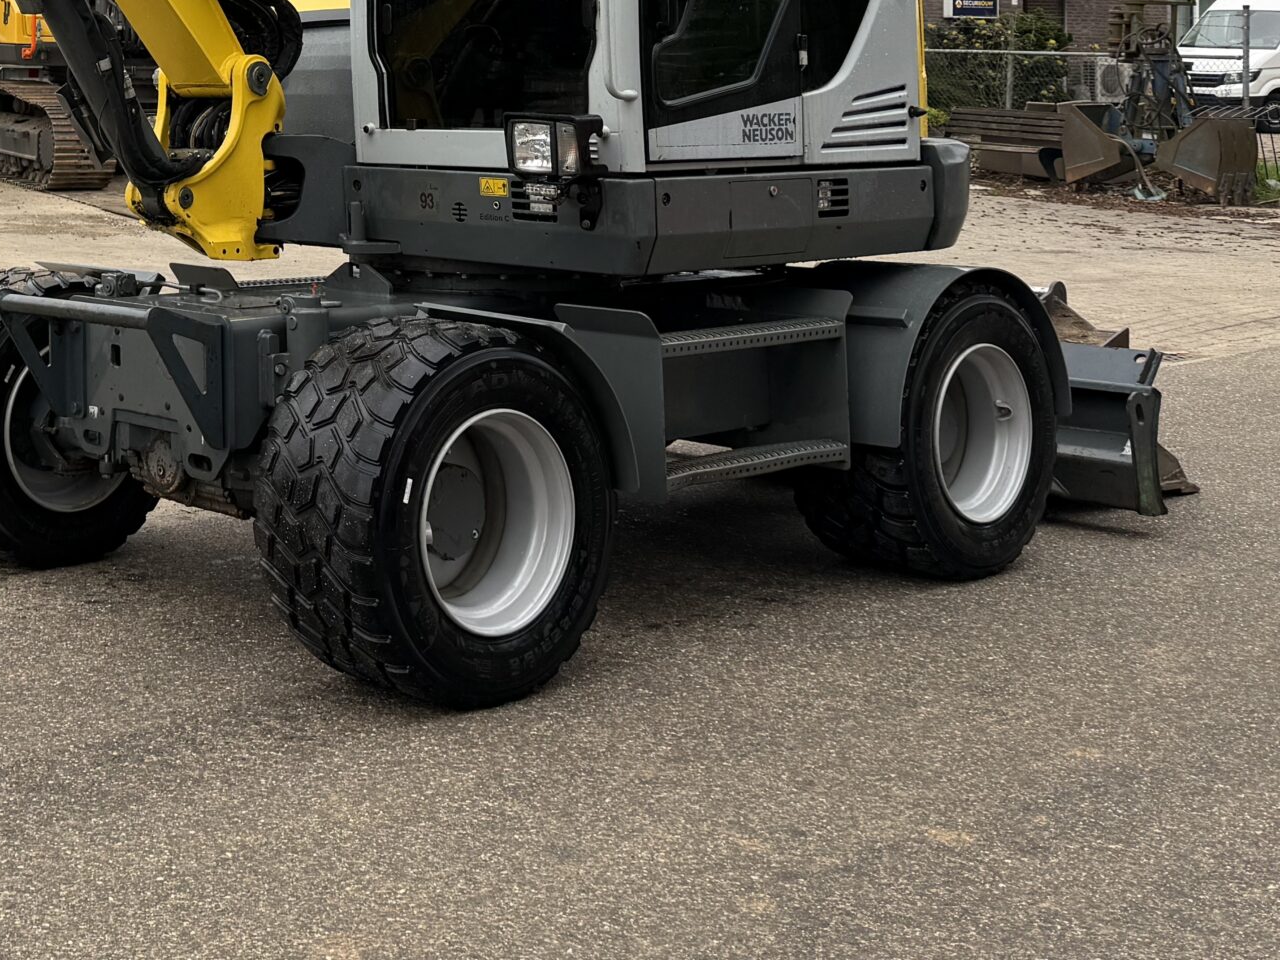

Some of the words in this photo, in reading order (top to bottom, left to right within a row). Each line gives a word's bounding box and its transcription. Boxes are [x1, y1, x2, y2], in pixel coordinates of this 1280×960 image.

[741, 112, 792, 128] WACKER
[742, 127, 794, 143] NEUSON
[420, 192, 434, 209] 93
[480, 213, 503, 222] Edition
